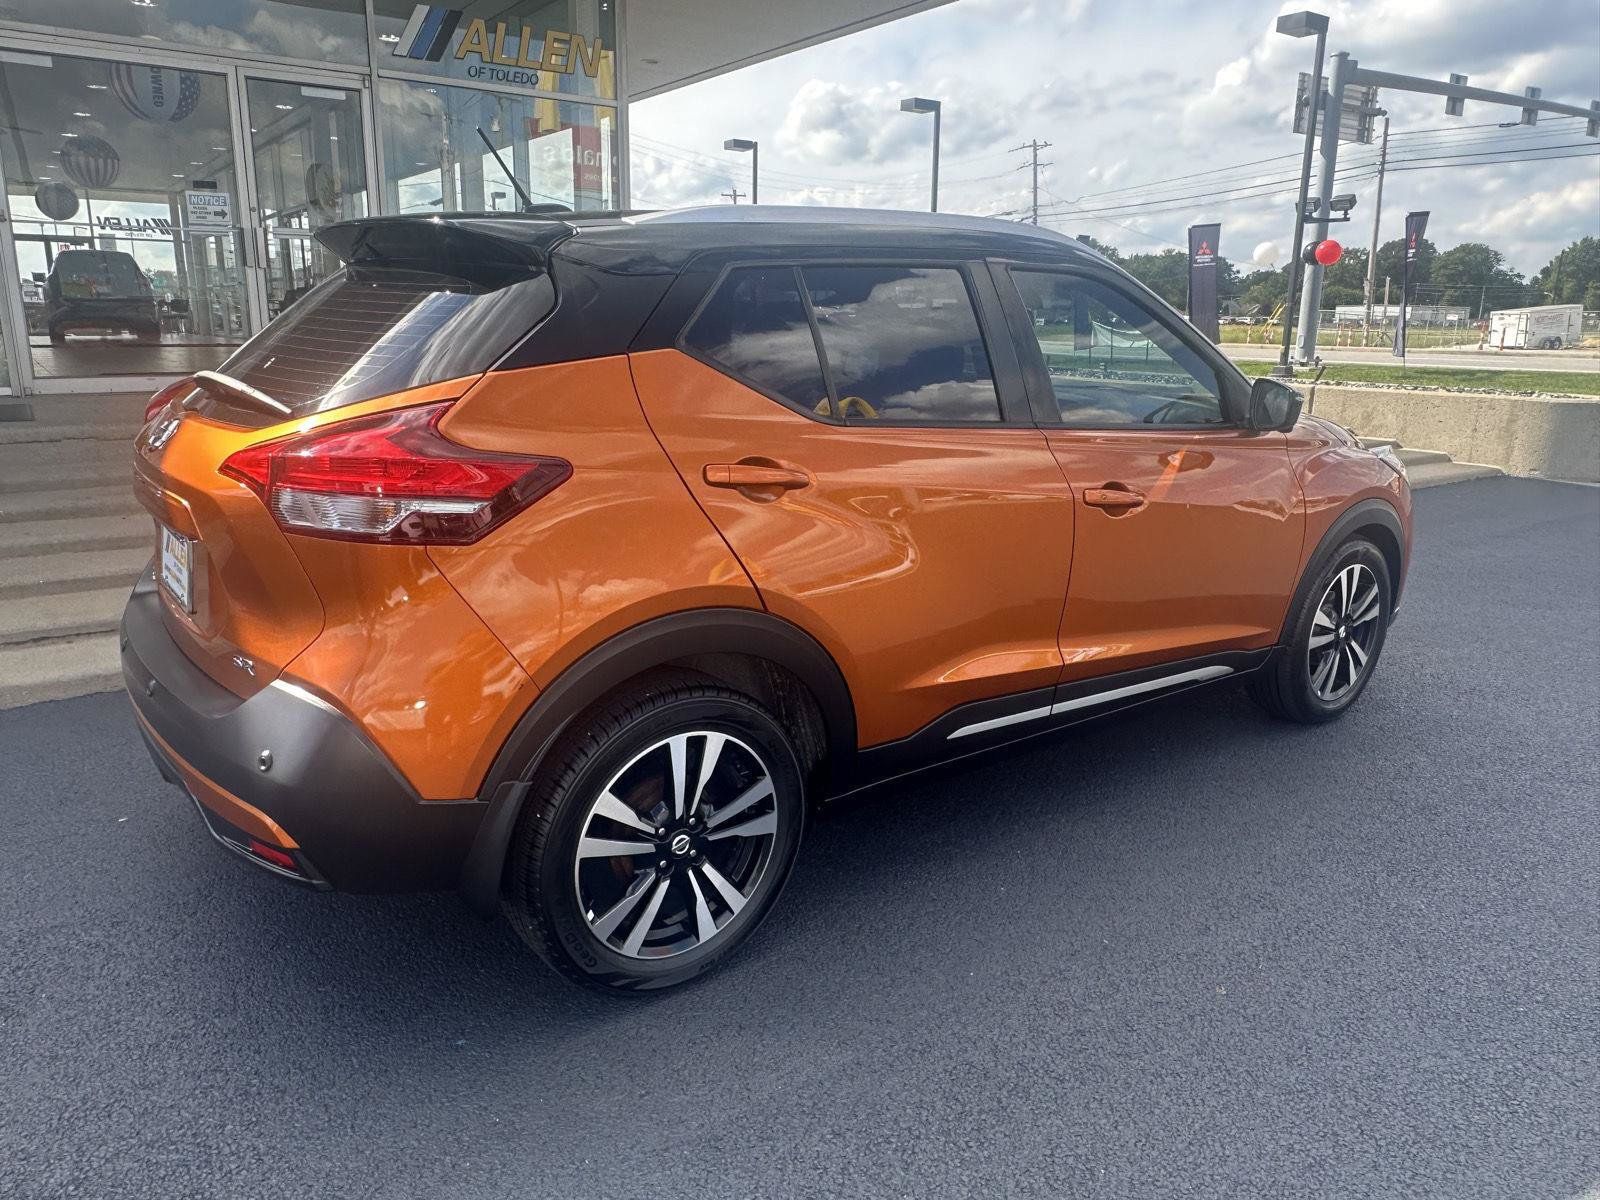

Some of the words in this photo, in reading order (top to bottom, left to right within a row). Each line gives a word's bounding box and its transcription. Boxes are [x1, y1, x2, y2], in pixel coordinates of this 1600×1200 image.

[455, 18, 602, 78] ALLEN
[467, 65, 488, 79] OF
[488, 67, 539, 85] TOLEDO
[190, 195, 226, 206] NOTICE
